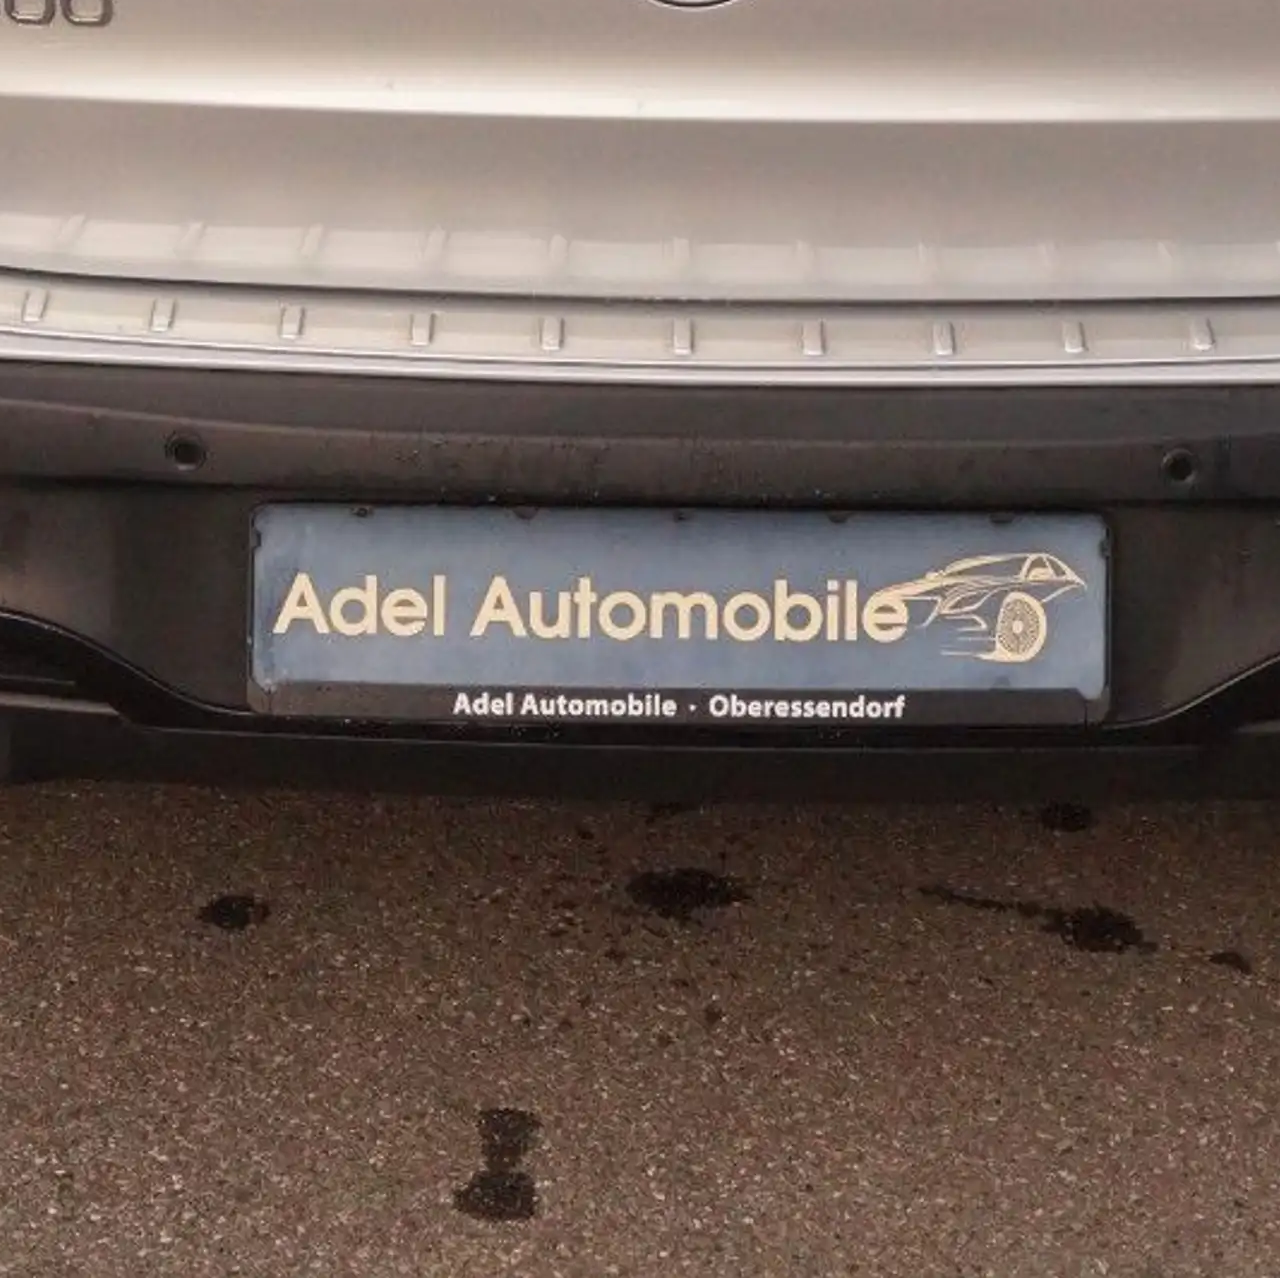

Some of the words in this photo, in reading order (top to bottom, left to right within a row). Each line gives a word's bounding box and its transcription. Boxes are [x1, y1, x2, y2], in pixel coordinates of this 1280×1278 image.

[272, 572, 446, 637] Adel
[469, 574, 911, 643] Automobile
[453, 691, 514, 717] Adel
[520, 692, 678, 718] Automobile
[709, 693, 906, 719] Oberessendorf
